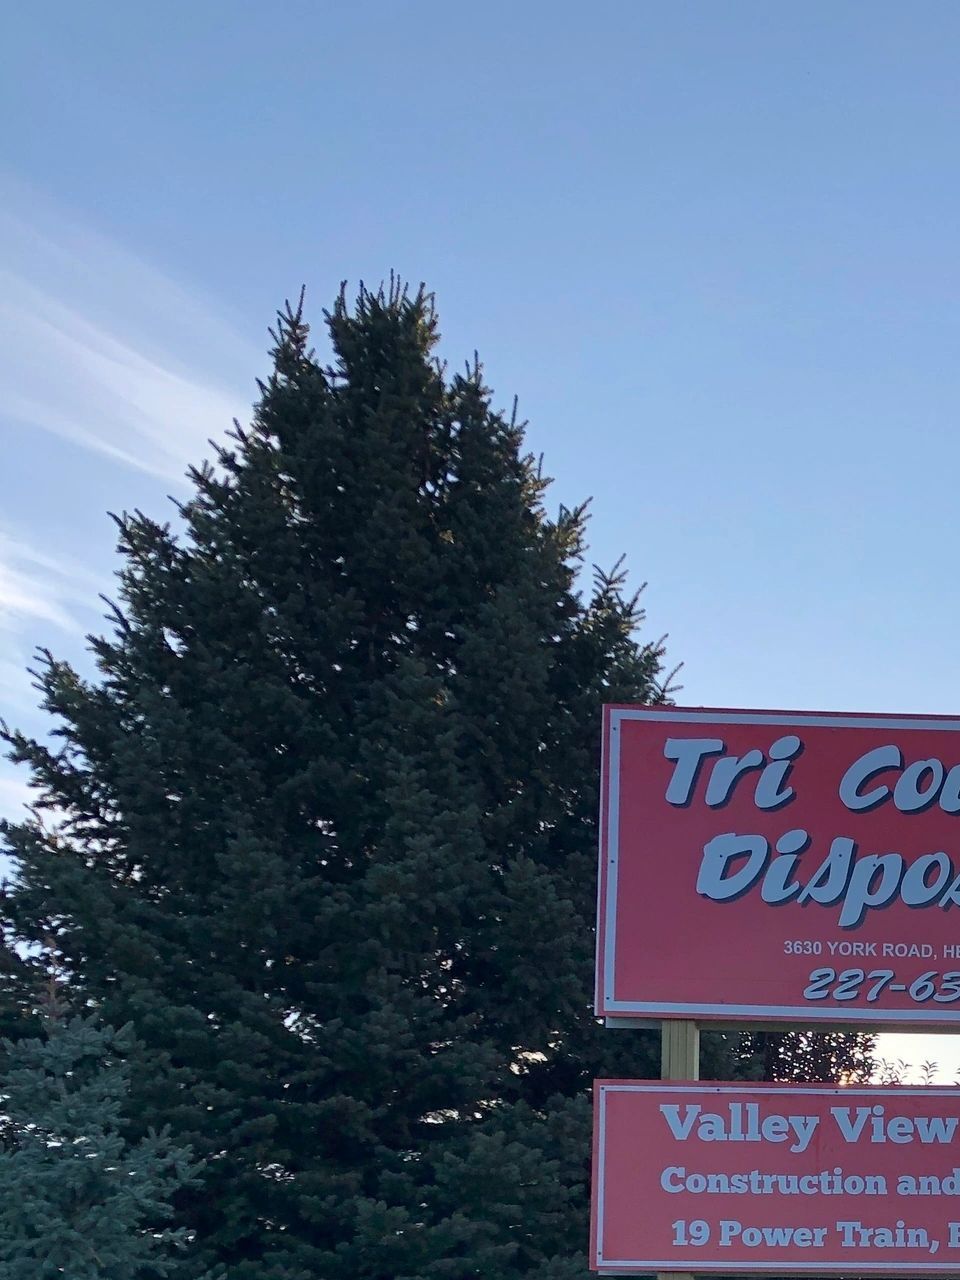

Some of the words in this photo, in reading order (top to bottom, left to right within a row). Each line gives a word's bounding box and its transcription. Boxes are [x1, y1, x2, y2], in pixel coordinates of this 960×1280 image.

[664, 735, 802, 810] Tri
[783, 940, 822, 957] 3630
[826, 941, 877, 958] YORK
[882, 942, 938, 961] ROAD,
[660, 1103, 819, 1153] Valley
[830, 1105, 958, 1144] View
[661, 1166, 888, 1196] Construction
[672, 1220, 710, 1246] 19
[720, 1221, 827, 1247] Power
[836, 1221, 940, 1254] Train,
